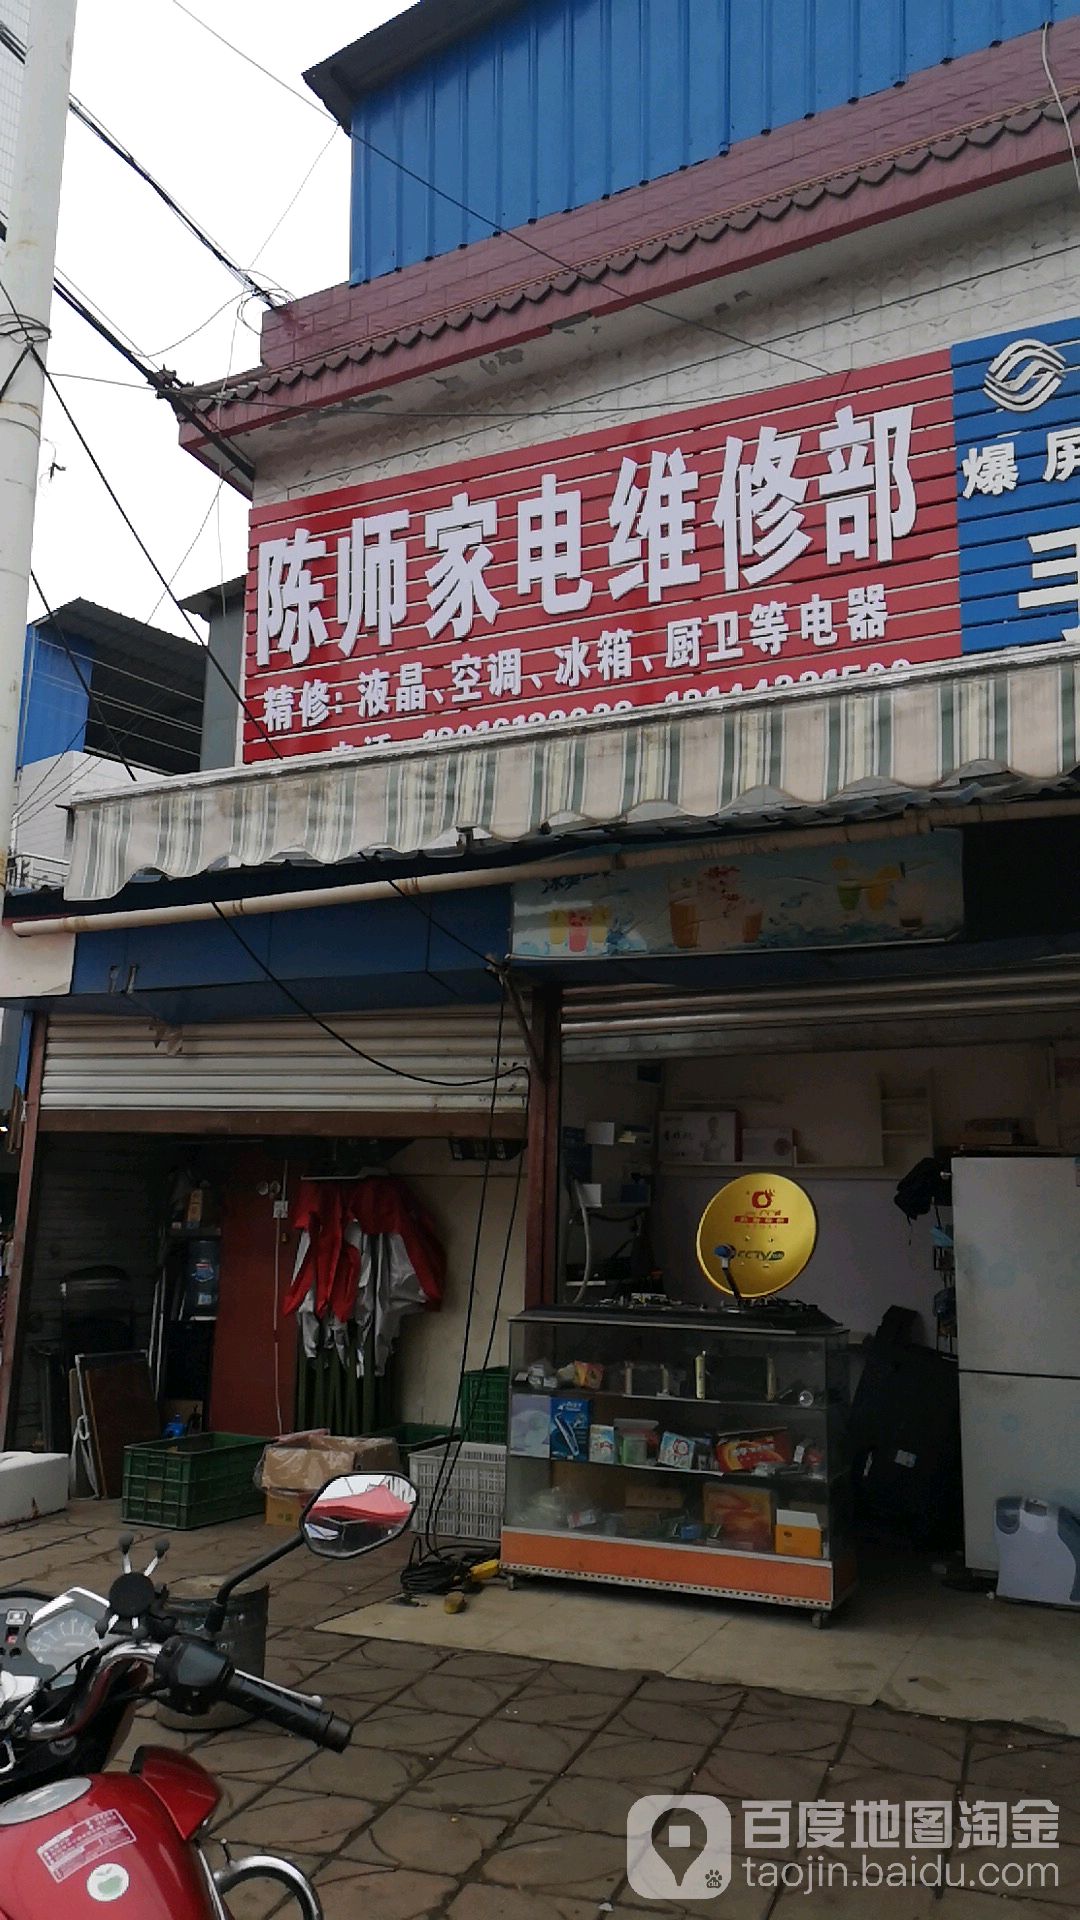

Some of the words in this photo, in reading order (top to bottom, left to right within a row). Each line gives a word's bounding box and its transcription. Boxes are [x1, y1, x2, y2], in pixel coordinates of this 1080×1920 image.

[256, 405, 917, 667] 陈师家电维修部
